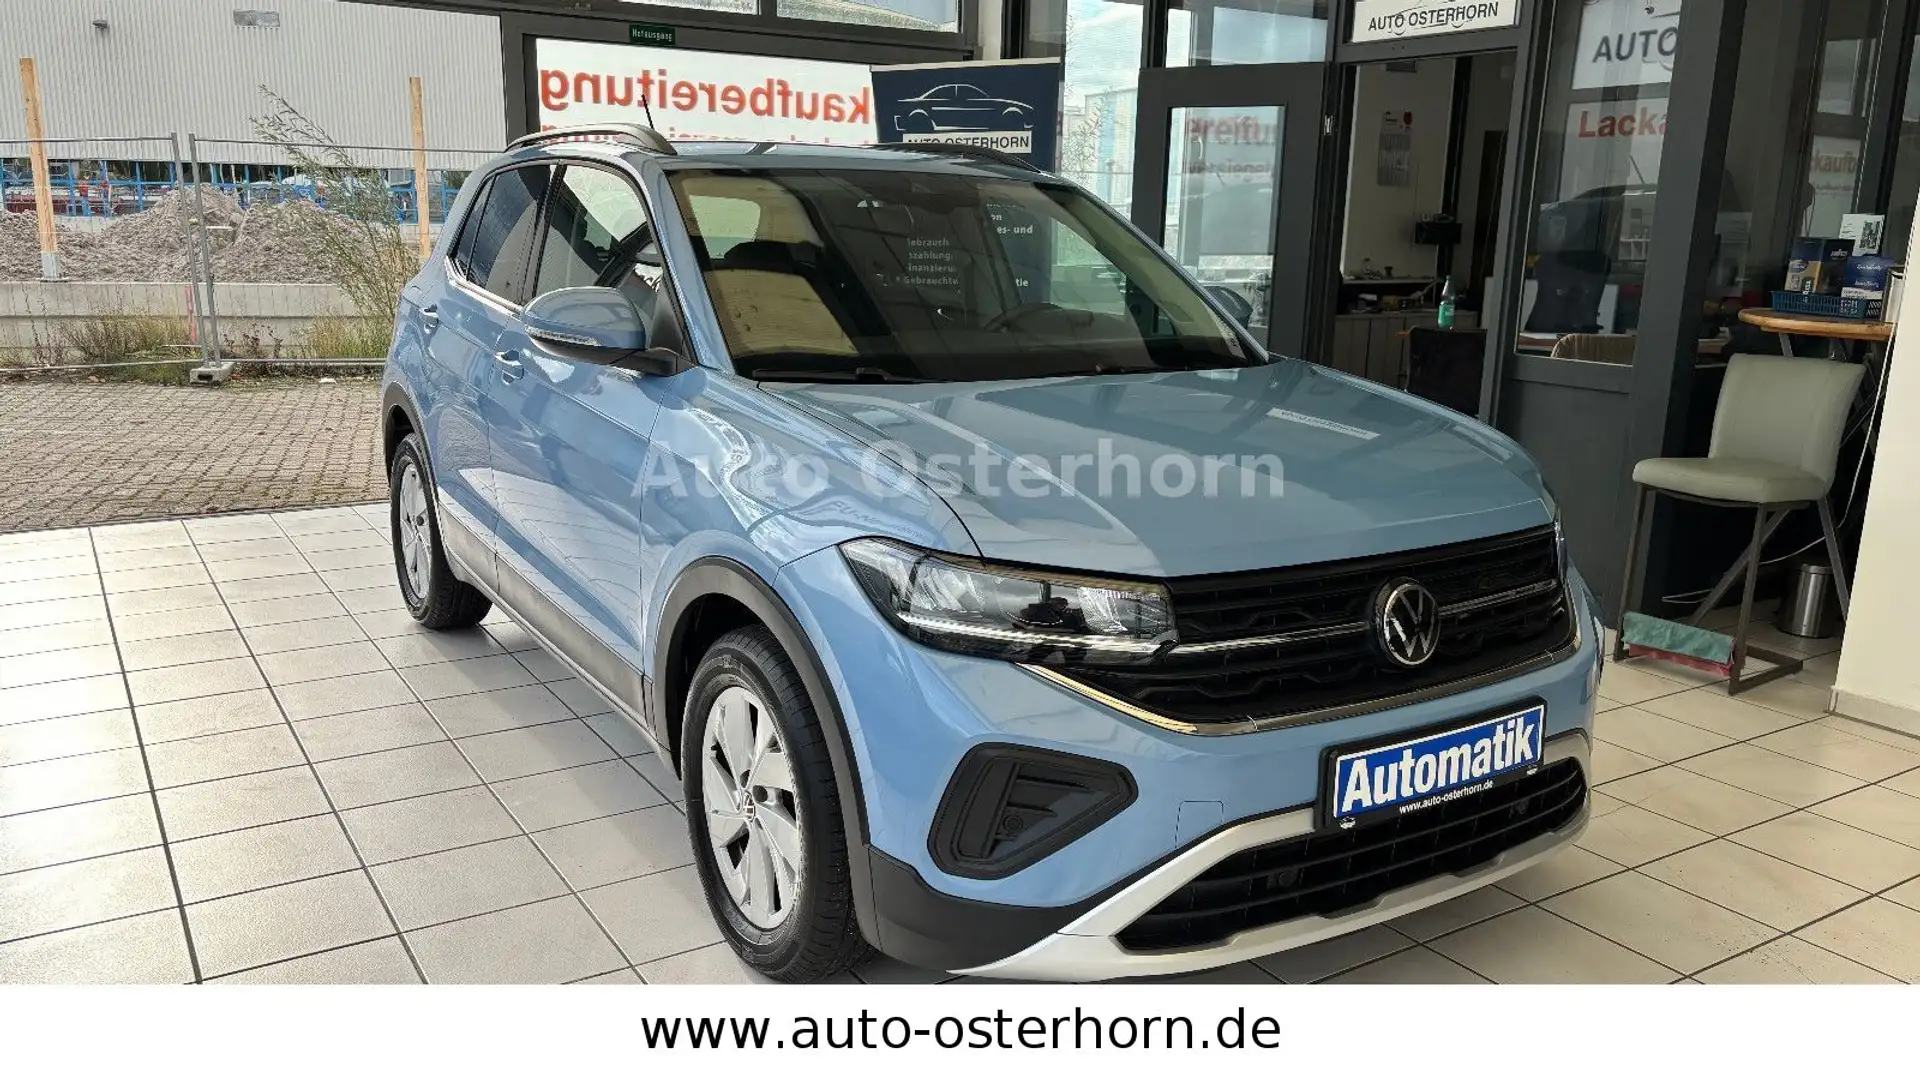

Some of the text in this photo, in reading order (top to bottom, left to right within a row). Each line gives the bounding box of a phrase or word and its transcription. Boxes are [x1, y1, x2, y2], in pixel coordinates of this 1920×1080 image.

[1368, 2, 1499, 31] AUTO OSTERHORN
[632, 28, 672, 42] Notausgang
[1592, 27, 1678, 63] AUTO
[1014, 225, 1033, 234] und
[1342, 716, 1534, 813] Automatik
[1399, 779, 1494, 815] www.auto-osterhorn.de
